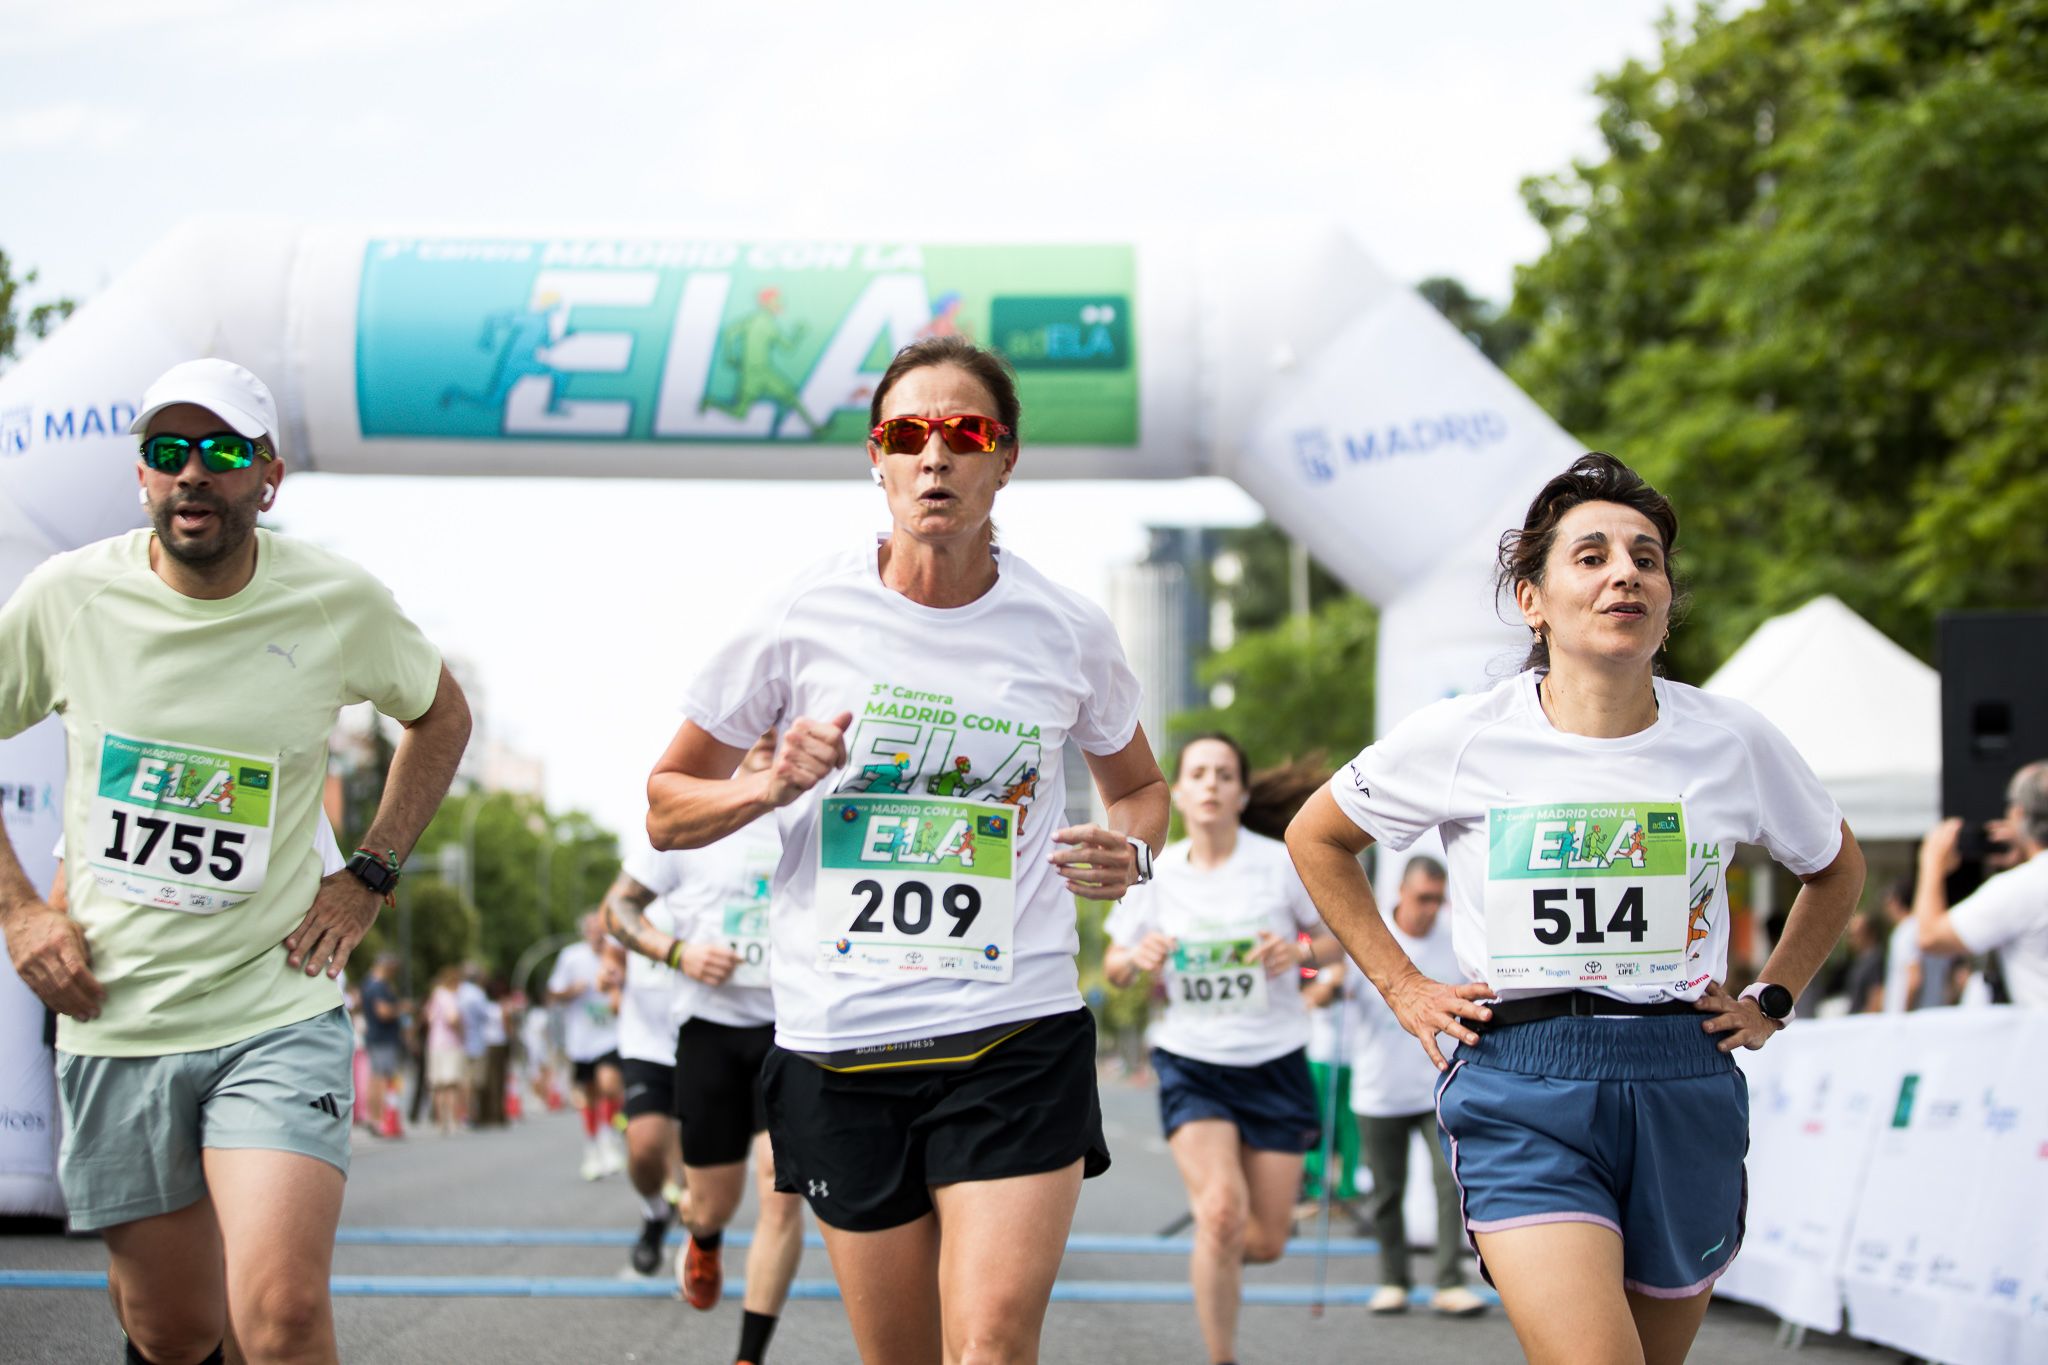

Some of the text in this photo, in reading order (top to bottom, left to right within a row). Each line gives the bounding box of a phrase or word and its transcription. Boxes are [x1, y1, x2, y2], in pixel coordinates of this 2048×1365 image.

[542, 242, 741, 265] MADRID
[744, 243, 856, 268] CON
[860, 244, 924, 269] LA
[503, 270, 935, 437] ELA
[45, 402, 136, 441] MAD
[1346, 410, 1508, 463] MADRID
[892, 686, 954, 705] Carrera
[864, 701, 1041, 740] MADRID CON LA
[141, 747, 188, 763] MADRID
[188, 754, 214, 767] CON
[214, 758, 231, 769] LA
[128, 757, 235, 815] ELA
[871, 803, 920, 815] MADRID
[923, 806, 950, 817] CON
[952, 807, 969, 818] LA
[1536, 808, 1588, 819] MADRID
[1590, 808, 1617, 819] CON
[1620, 807, 1636, 818] LA
[103, 809, 246, 882] 1755
[860, 815, 975, 867] ELA
[1527, 819, 1646, 871] ELA
[1702, 842, 1720, 859] LA
[848, 879, 982, 938] 209
[1532, 887, 1648, 945] 514
[1545, 968, 1571, 978] Biogen
[1656, 963, 1678, 972] MADRID
[1182, 973, 1254, 1002] 1029
